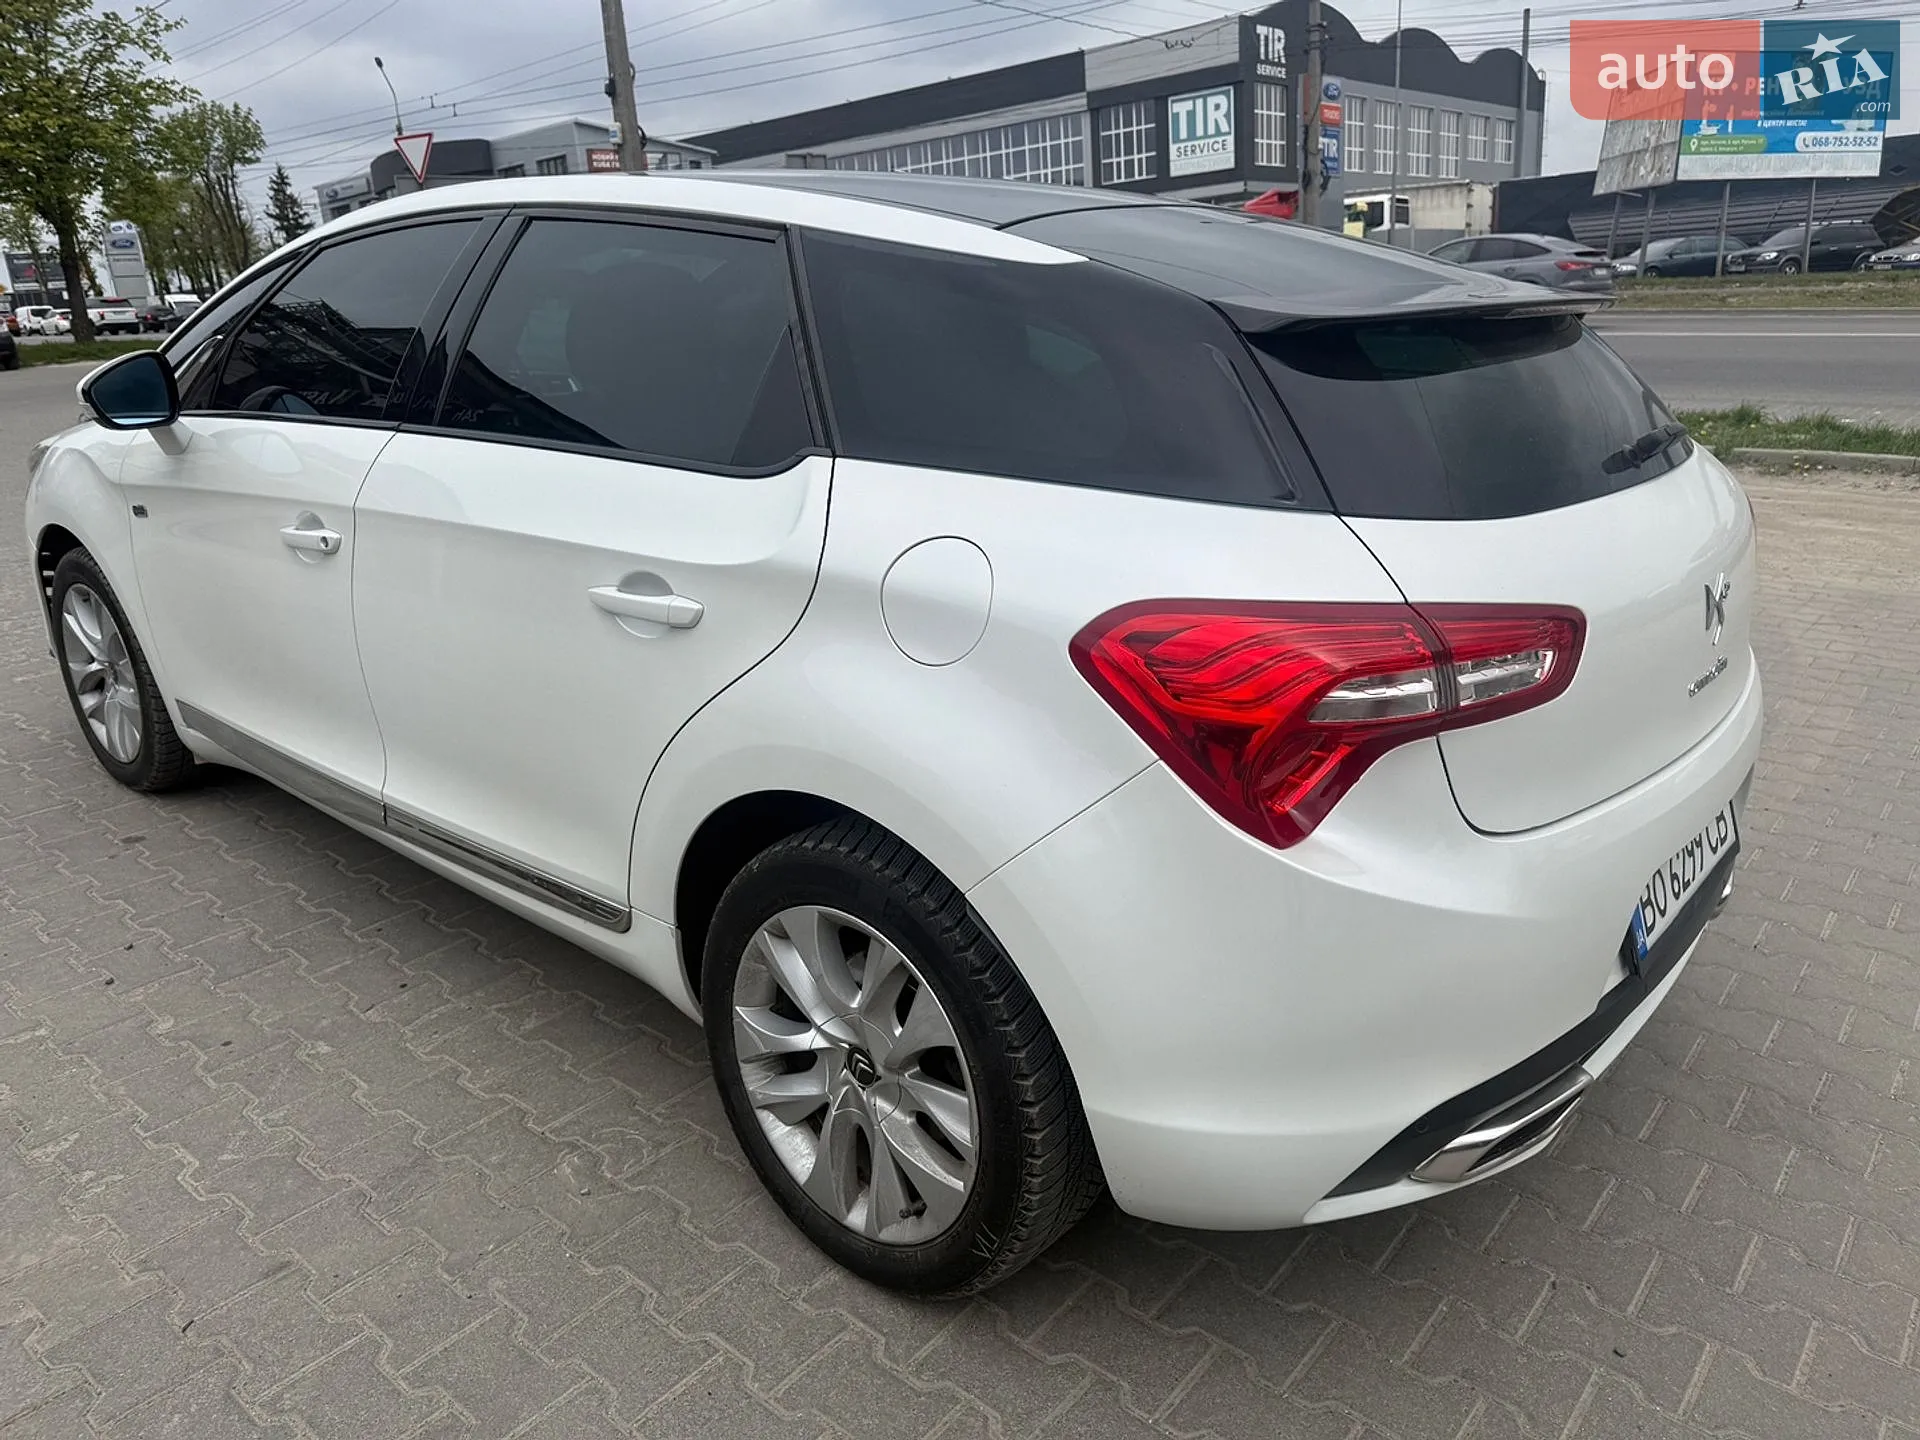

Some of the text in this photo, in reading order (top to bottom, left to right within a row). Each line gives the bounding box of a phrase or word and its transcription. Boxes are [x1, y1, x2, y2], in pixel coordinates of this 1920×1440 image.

[1256, 24, 1286, 64] TIR
[1256, 63, 1287, 79] SERVICE
[1172, 94, 1230, 140] TIR
[1176, 140, 1228, 158] SERVICE
[1811, 136, 1878, 147] 068-752-52-52
[1639, 868, 1667, 937] BO
